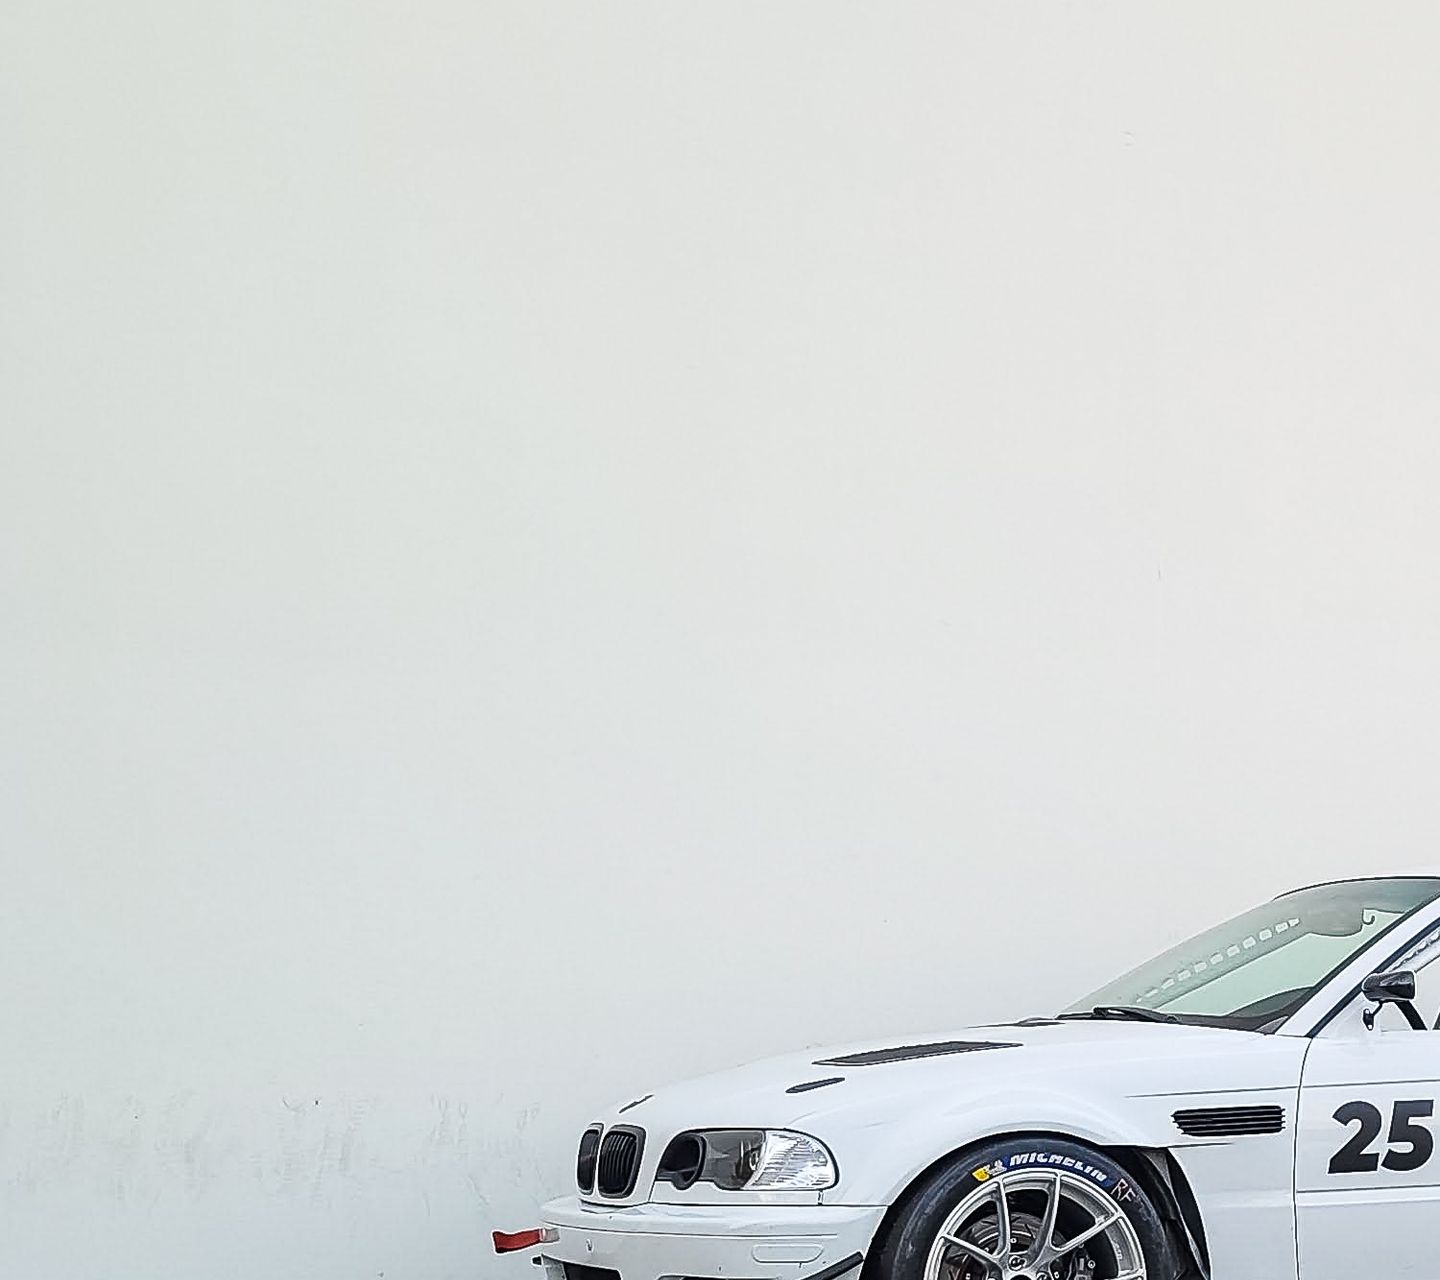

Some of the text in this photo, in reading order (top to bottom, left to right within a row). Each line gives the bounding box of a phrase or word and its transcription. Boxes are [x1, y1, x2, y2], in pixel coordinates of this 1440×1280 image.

[1327, 1099, 1434, 1174] 25
[1009, 1152, 1108, 1182] MICHELIN
[1110, 1178, 1137, 1202] RF
